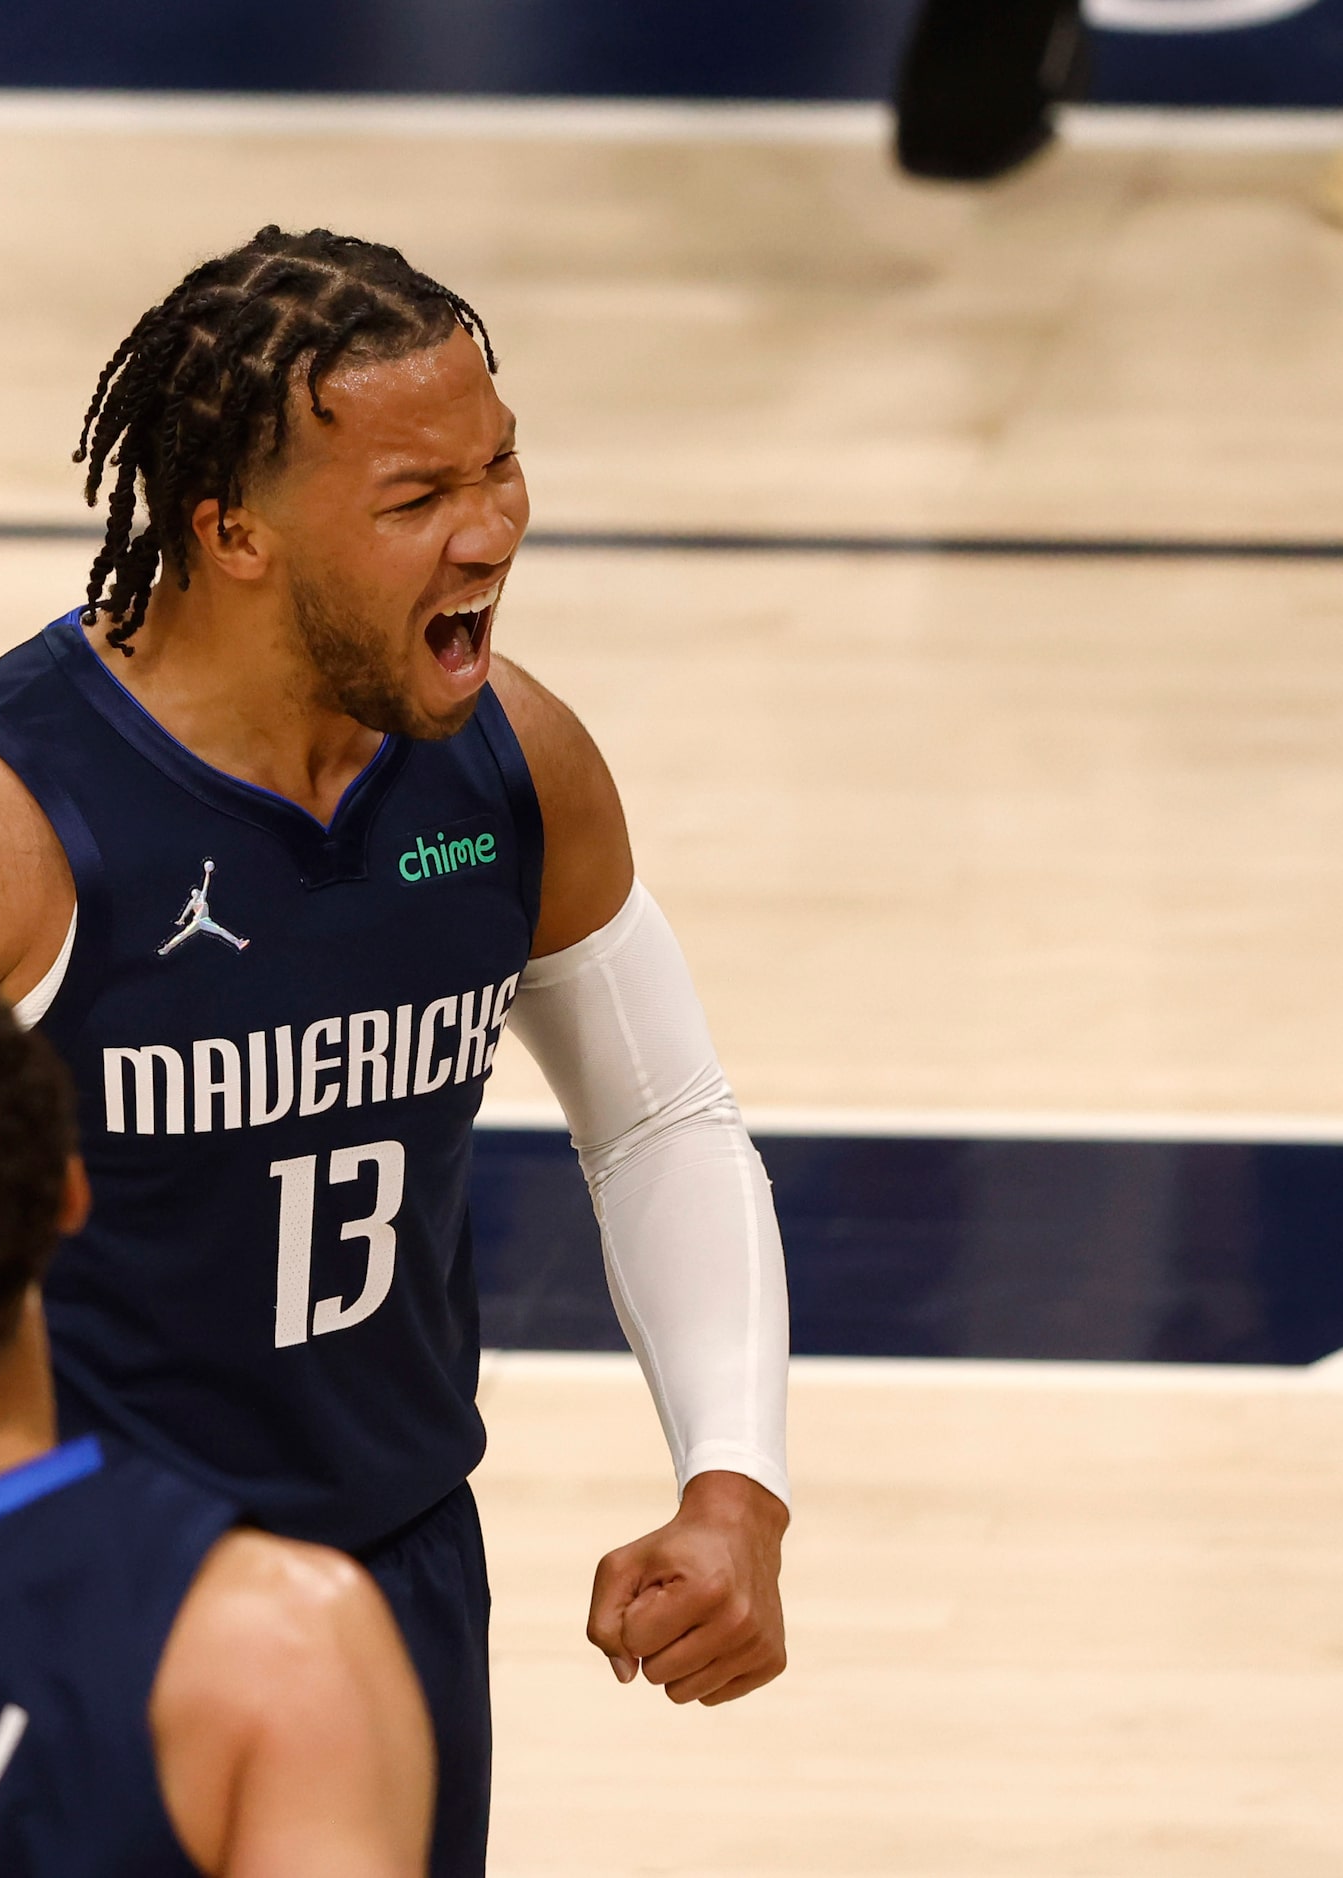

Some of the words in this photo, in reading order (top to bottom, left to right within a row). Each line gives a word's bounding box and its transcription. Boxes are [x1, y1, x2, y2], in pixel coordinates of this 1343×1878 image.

[399, 832, 496, 881] chime
[103, 972, 520, 1135] MAVERICKS
[269, 1139, 405, 1348] 13
